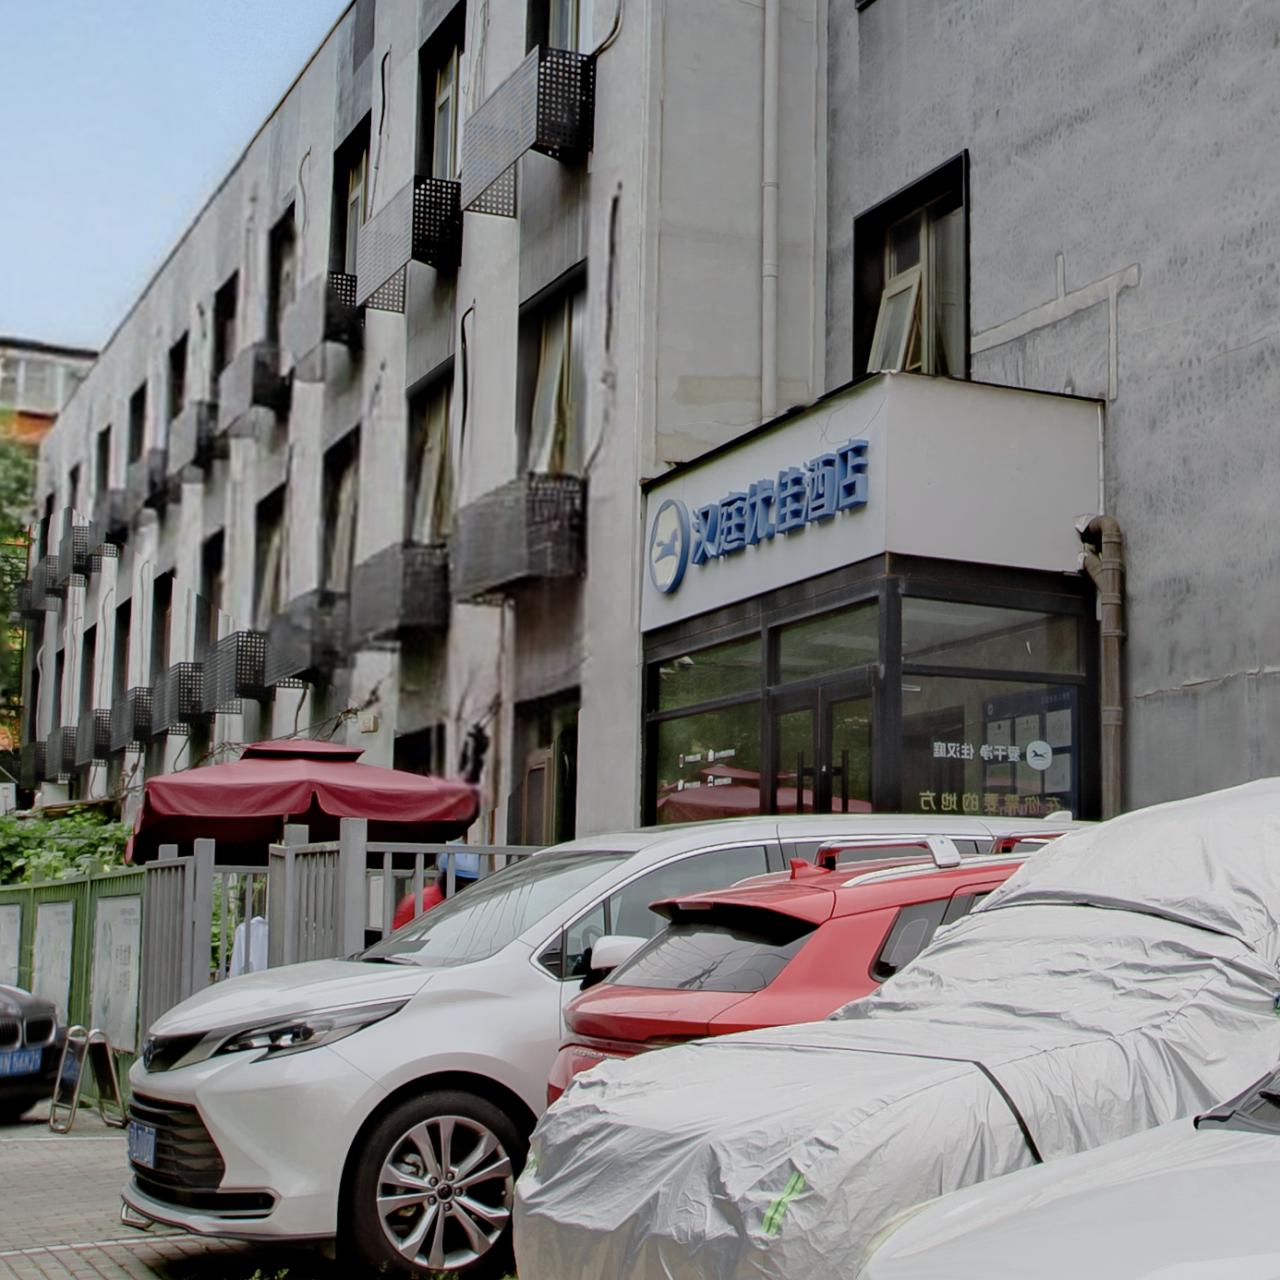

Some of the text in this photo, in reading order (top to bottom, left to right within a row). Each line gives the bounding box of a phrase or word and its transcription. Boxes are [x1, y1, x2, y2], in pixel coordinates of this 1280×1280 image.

[691, 439, 869, 565] 汉庭优佳酒店
